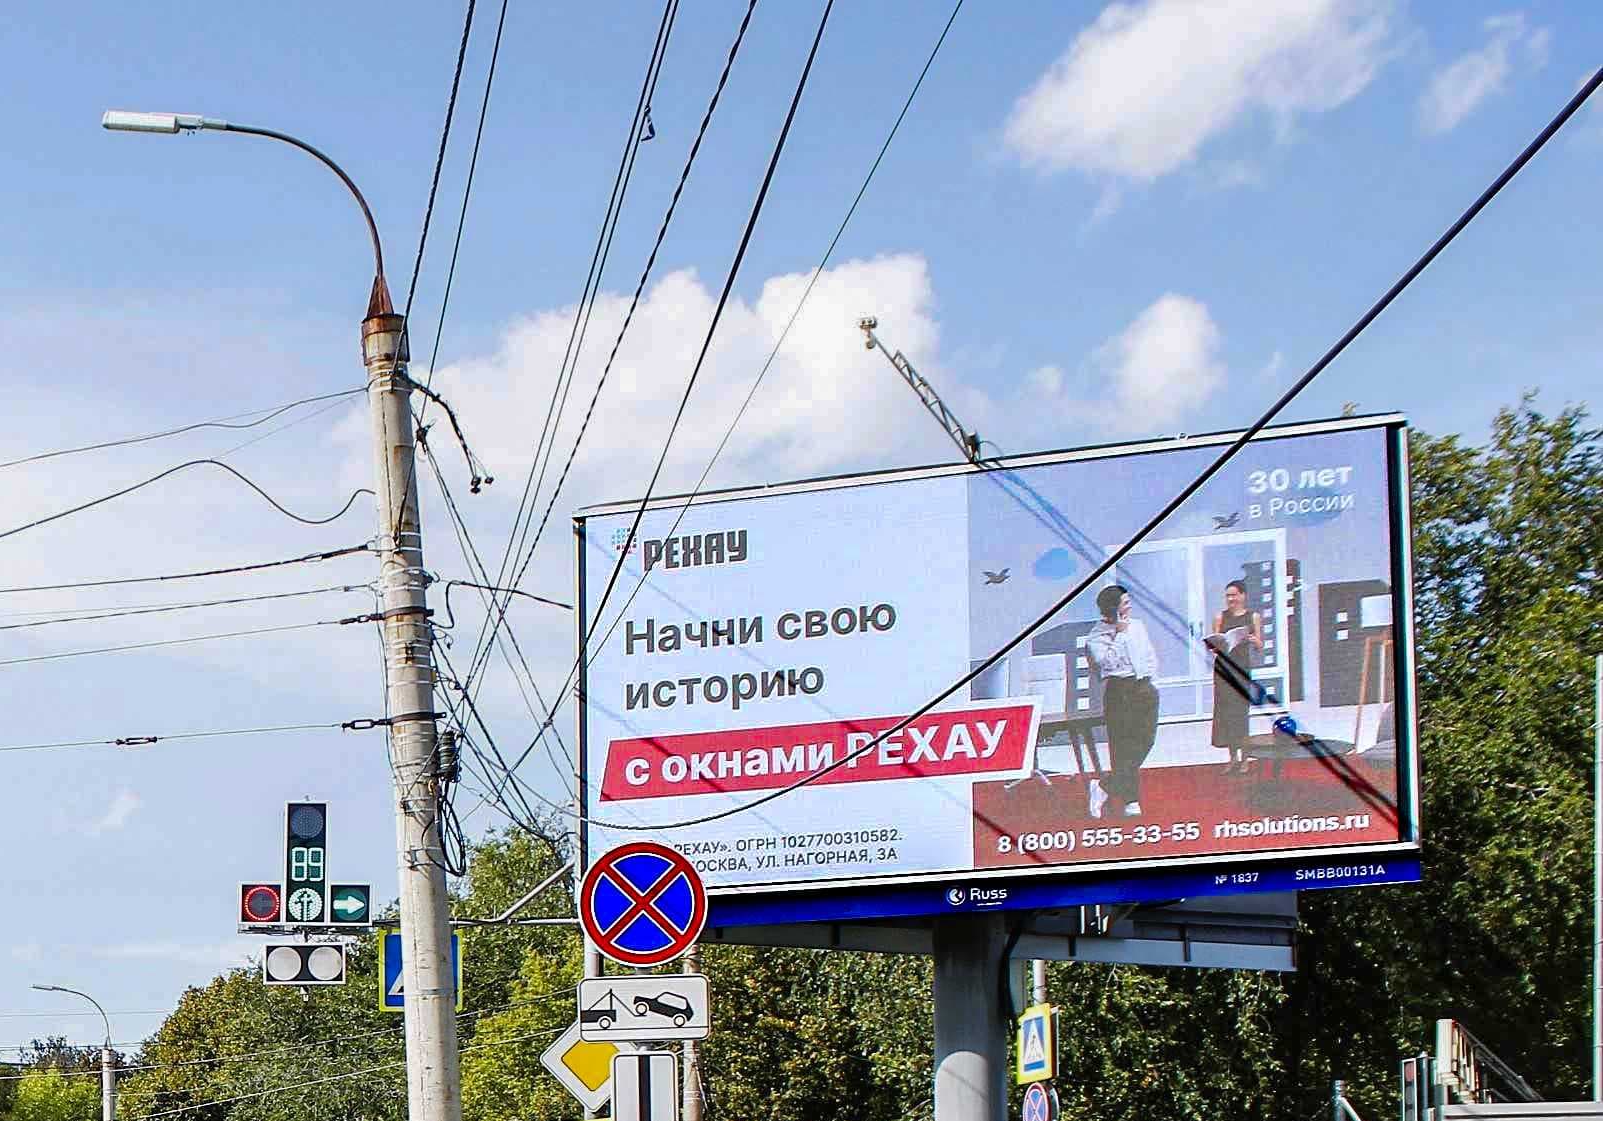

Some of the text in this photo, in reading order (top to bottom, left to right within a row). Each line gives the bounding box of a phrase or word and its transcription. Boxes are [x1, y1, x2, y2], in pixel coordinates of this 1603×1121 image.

[1249, 466, 1353, 494] 30 лет
[1249, 493, 1354, 519] в России
[643, 529, 747, 572] РЕХАУ
[625, 603, 896, 655] Начни свою
[625, 666, 824, 710] историю
[625, 719, 1007, 785] с окнами РЕХАУ
[736, 837, 776, 852] ОГРН
[781, 828, 903, 849] 1027700310582.
[997, 822, 1200, 852] 8 (800) 555-33-55
[1213, 813, 1370, 839] rhsolutions.ru
[291, 846, 324, 882] 89
[692, 857, 752, 873] ОСКВА,
[756, 855, 780, 869] УЛ.
[784, 848, 872, 867] НАГОРНАЯ,
[1231, 872, 1259, 884] 1837
[970, 887, 1007, 901] Russ
